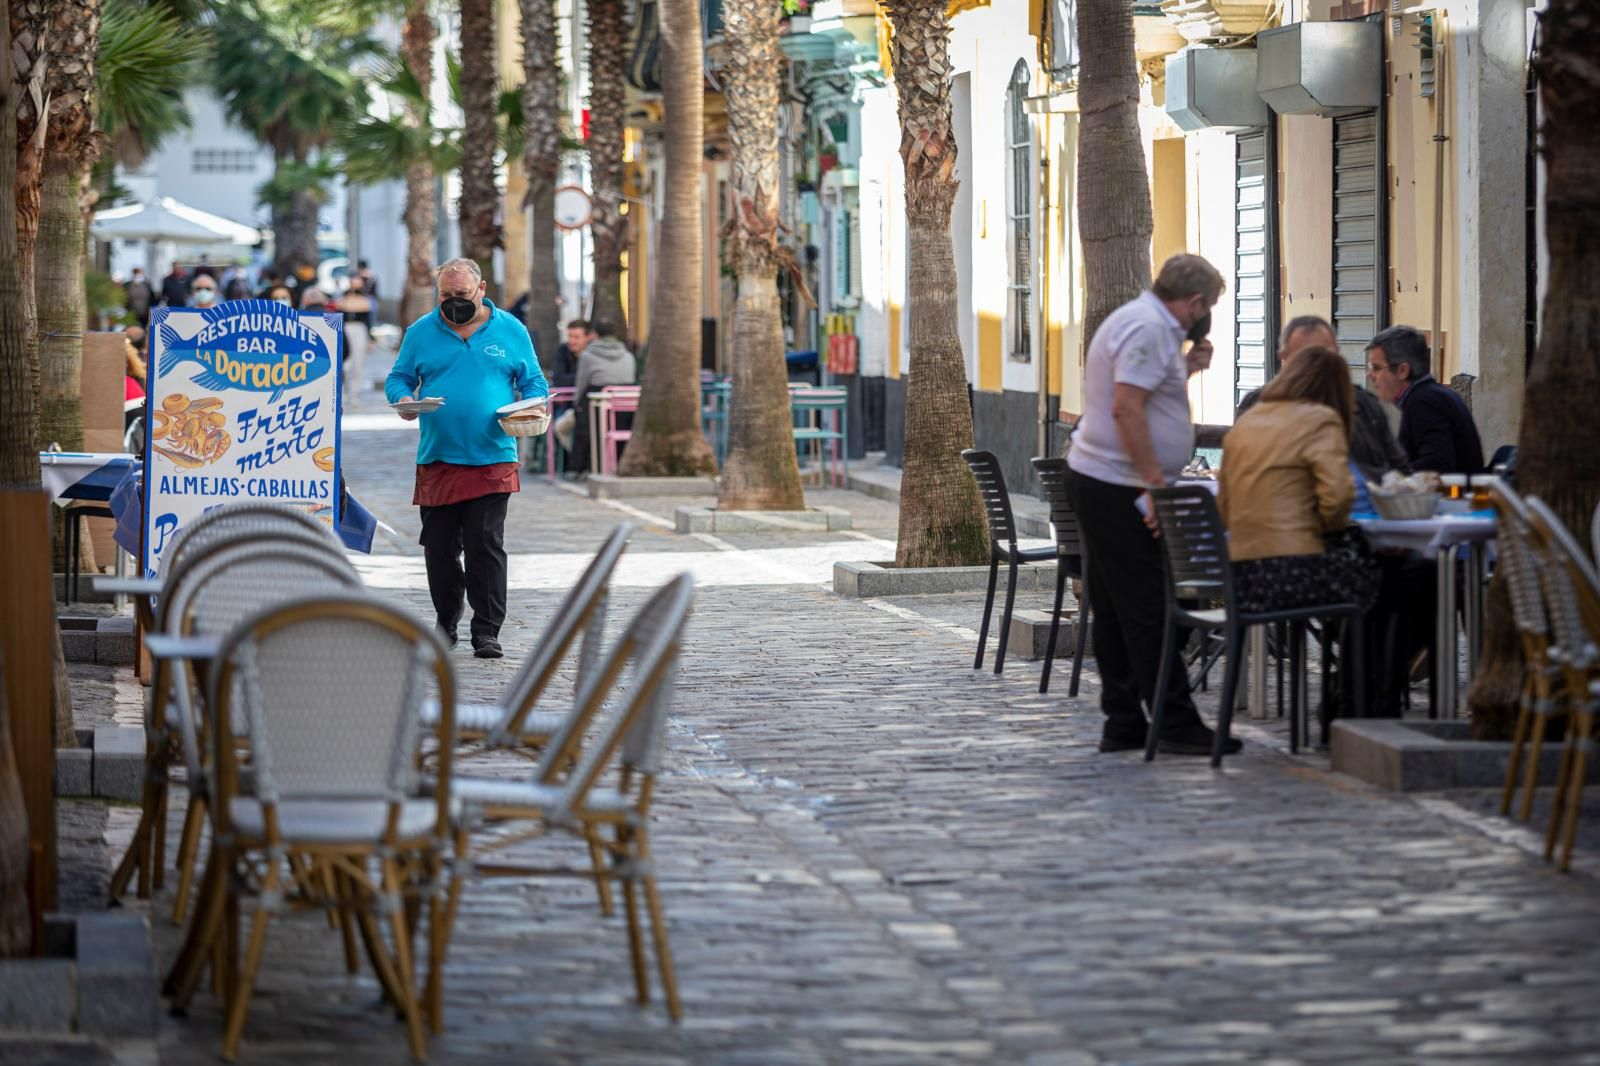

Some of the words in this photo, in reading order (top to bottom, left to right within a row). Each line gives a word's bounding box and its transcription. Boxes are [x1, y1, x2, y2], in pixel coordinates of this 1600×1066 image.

[196, 312, 318, 347] RESTAURANTE
[236, 336, 277, 355] BAR
[195, 348, 212, 366] LA
[215, 349, 307, 388] Dorada
[237, 395, 321, 443] Frito
[236, 424, 324, 474] mixto
